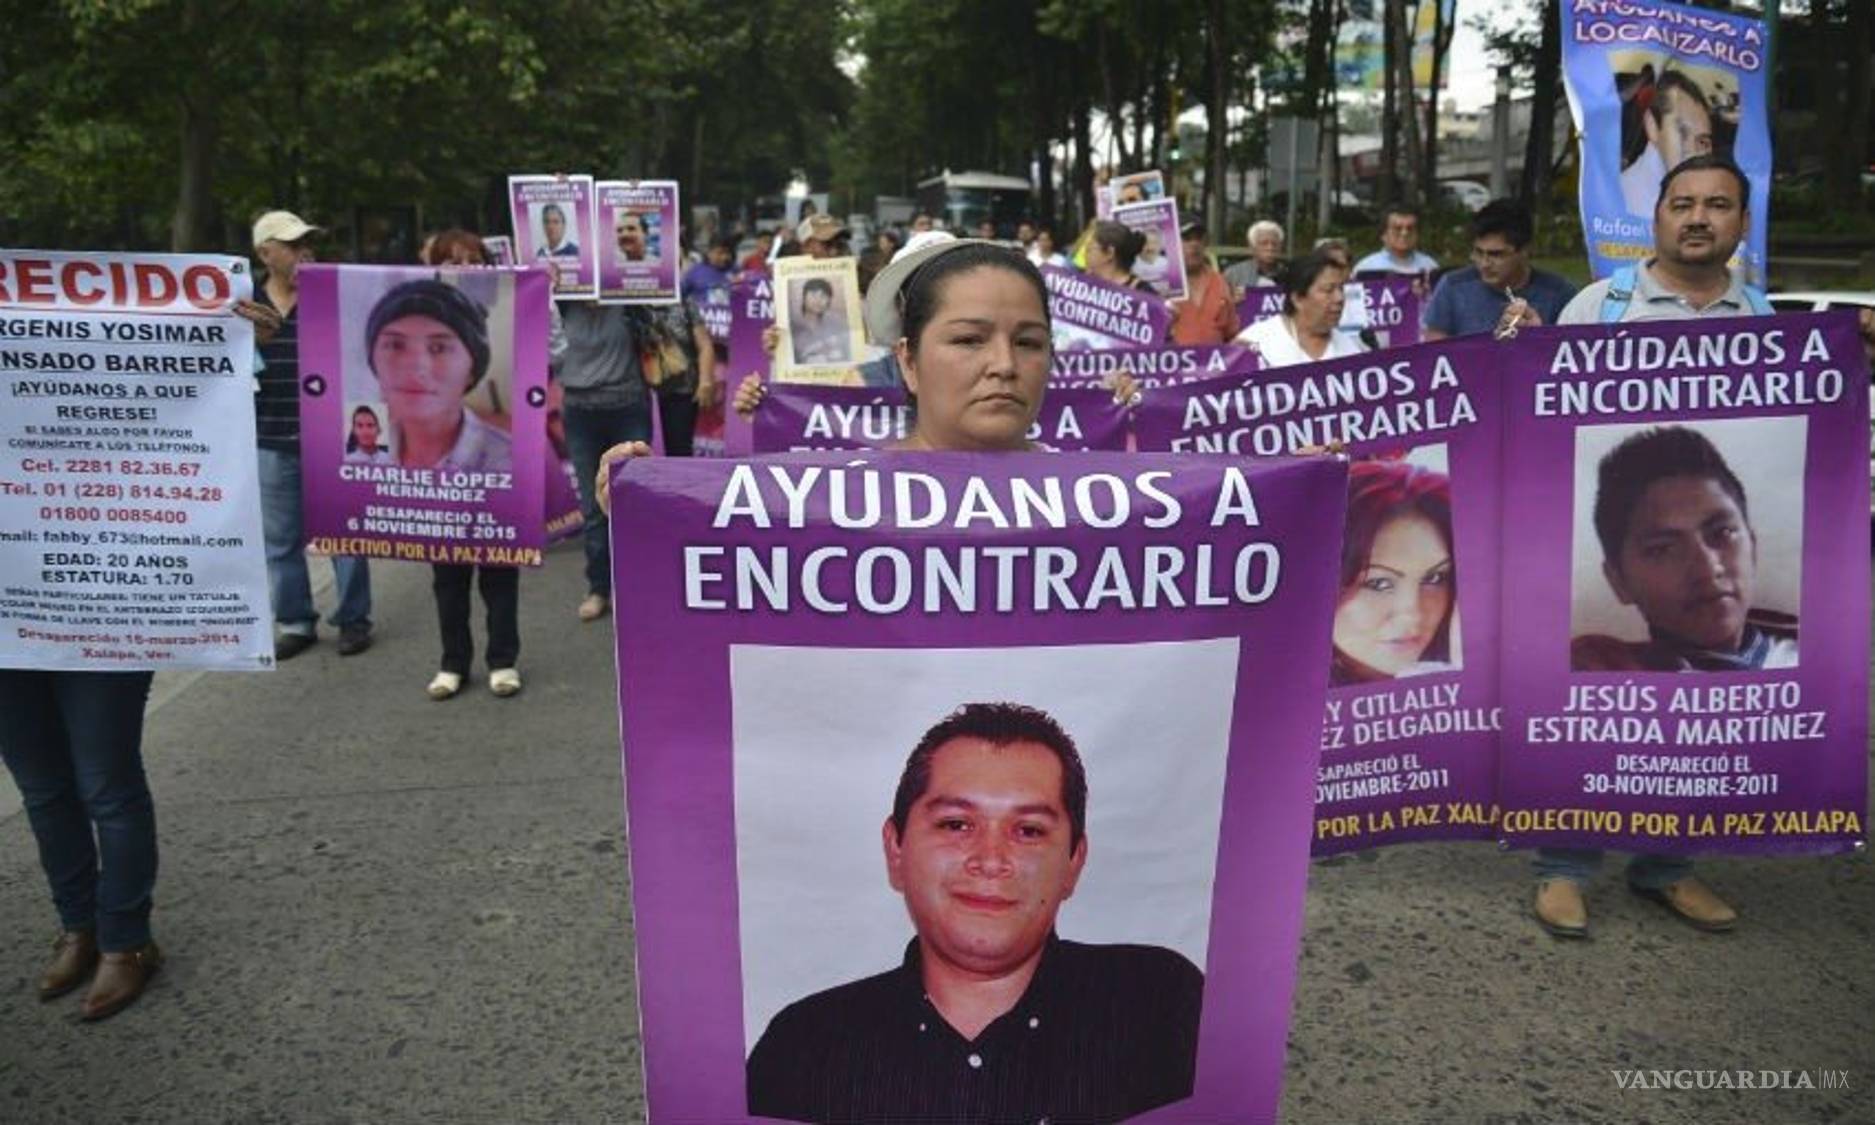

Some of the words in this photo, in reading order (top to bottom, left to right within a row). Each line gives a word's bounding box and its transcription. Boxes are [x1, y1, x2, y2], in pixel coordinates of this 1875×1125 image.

[1576, 21, 1760, 69] LOCALIZARLO
[1380, 288, 1395, 305] A
[1137, 302, 1149, 320] A
[102, 323, 226, 343] YOSIMAR
[1207, 350, 1227, 371] A
[1550, 330, 1786, 374] AYÚDANOS
[1802, 328, 1830, 363] A
[106, 355, 234, 373] BARRERA
[135, 386, 151, 398] A
[155, 386, 198, 398] QUE
[1182, 361, 1415, 431] AYÚDANOS
[1430, 356, 1458, 390] A
[1534, 369, 1843, 416] ENCONTRARLO
[57, 405, 157, 420] REGRESE!
[1055, 405, 1083, 439] A
[124, 428, 148, 437] POR
[107, 442, 132, 450] LOS
[21, 459, 59, 473] Cel.
[67, 460, 111, 474] 2281
[340, 465, 433, 485] CHARLIE
[1, 482, 37, 496] Tel.
[44, 483, 65, 496] 01
[74, 483, 123, 500] (228)
[712, 460, 1182, 528] AYÚDANOS
[1210, 467, 1260, 527] A
[40, 507, 100, 521] 01800
[477, 513, 496, 524] EL
[347, 519, 358, 530] 6
[364, 519, 466, 539] NOVIEMBRE
[474, 527, 516, 539] 2015
[44, 553, 100, 566] EDAD:
[108, 555, 129, 567] 20
[312, 538, 390, 555] COLECTIVO
[396, 544, 424, 559] POR
[430, 546, 448, 560] LA
[453, 547, 481, 562] PAZ
[42, 570, 147, 585] ESTATURA:
[154, 573, 193, 585] 1.70
[683, 542, 1280, 613] ENCONTRARLO
[1352, 683, 1460, 719] CITLALLY
[1563, 680, 1658, 712] JESÚS
[1669, 681, 1800, 714] ALBERTO
[1527, 717, 1664, 744] ESTRADA
[1675, 711, 1826, 745] MARTÍNEZ
[1403, 754, 1421, 770] EL
[1616, 753, 1730, 774] DESAPARECIÓ
[1734, 755, 1751, 772] EL
[1583, 773, 1779, 796] 30-NOVIEMBRE-2011
[1317, 815, 1361, 839] POR
[1368, 811, 1395, 833] LA
[1402, 804, 1441, 828] PAZ
[1503, 809, 1622, 834] COLECTIVO
[1630, 812, 1680, 836] POR
[1688, 815, 1716, 836] LA
[1724, 813, 1765, 835] PAZ
[1772, 810, 1860, 834] XALAPA
